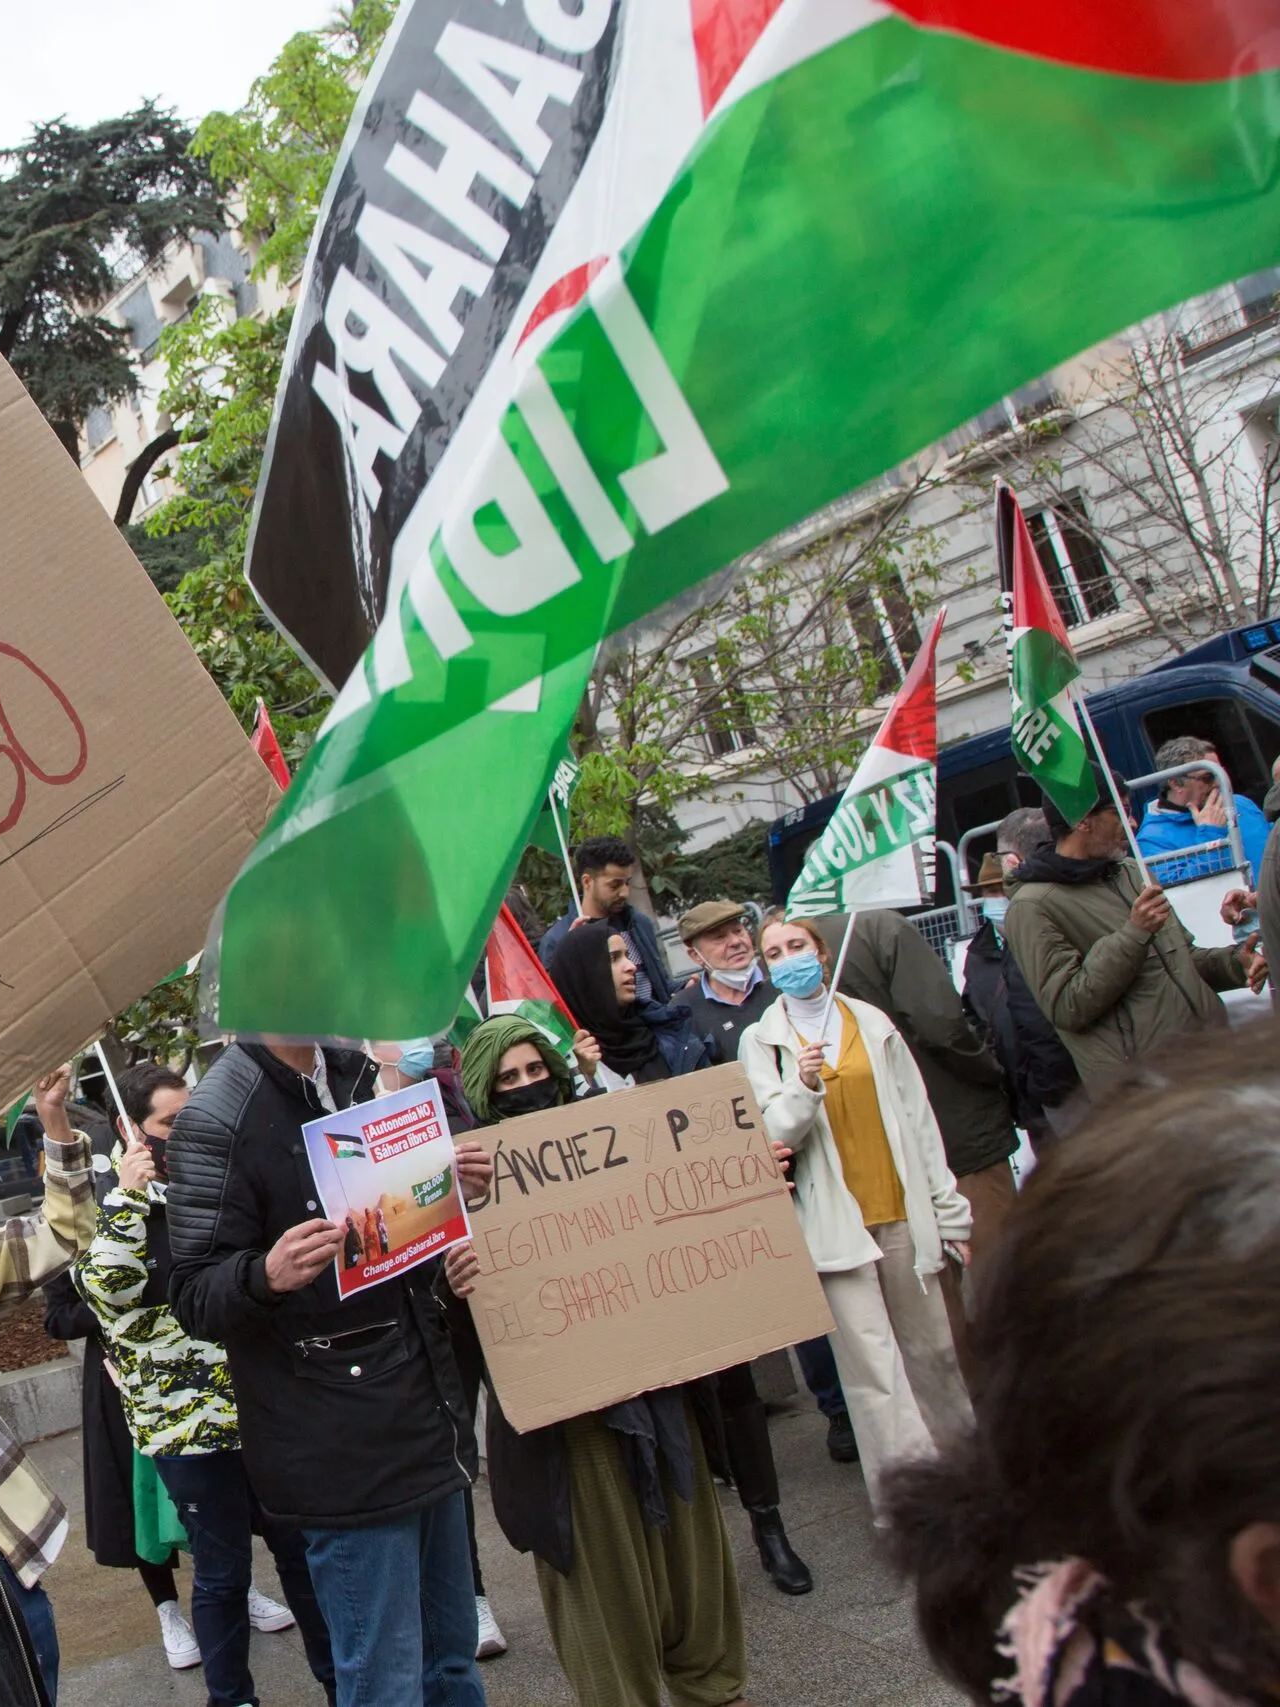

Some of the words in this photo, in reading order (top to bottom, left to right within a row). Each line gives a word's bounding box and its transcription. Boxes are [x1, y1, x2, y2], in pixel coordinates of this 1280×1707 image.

[364, 1109, 418, 1143] ¡Autonomía
[417, 1103, 435, 1120] NO,
[373, 1137, 409, 1161] Sáhara
[407, 1131, 428, 1149] libre
[628, 1117, 656, 1164] Y
[665, 1095, 756, 1153] PSOE
[424, 1187, 444, 1206] firmas
[619, 1194, 643, 1231] LA
[645, 1131, 782, 1217] OCUPACIÓN
[362, 1230, 446, 1278] Change.org/SaharaLibre
[485, 1300, 536, 1346] DEL
[538, 1261, 641, 1337] SAHARA
[646, 1226, 793, 1299] OCCIDENTAL
